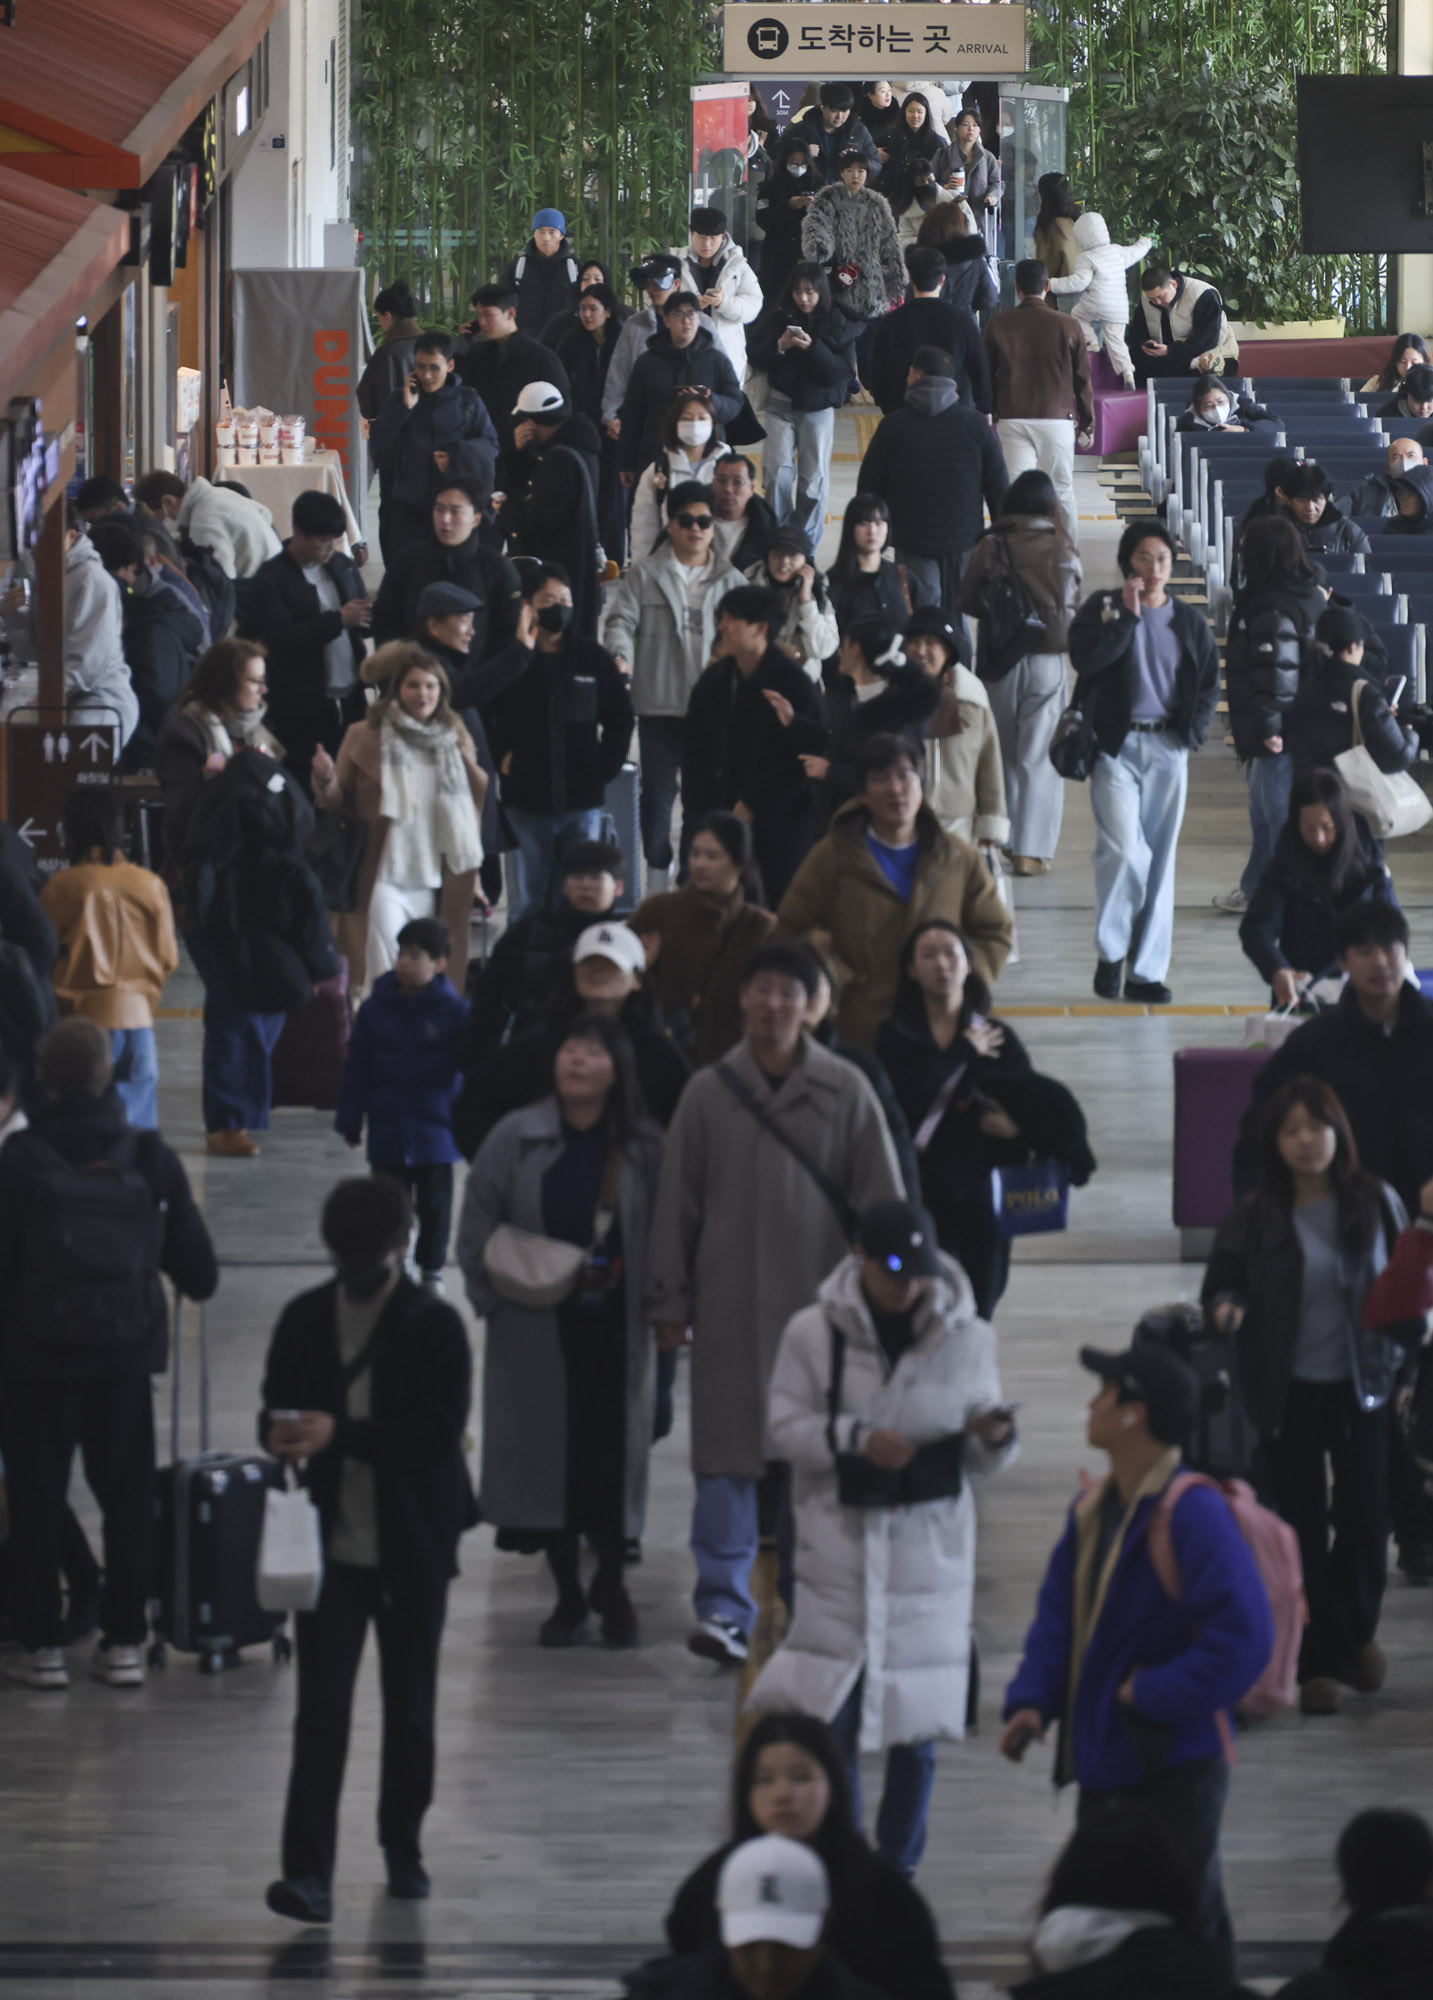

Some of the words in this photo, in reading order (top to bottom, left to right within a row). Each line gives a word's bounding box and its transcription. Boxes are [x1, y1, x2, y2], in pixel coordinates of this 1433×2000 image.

[798, 24, 914, 53] 도착하는
[922, 25, 951, 54] 곳
[957, 43, 1009, 54] ARRIVAL
